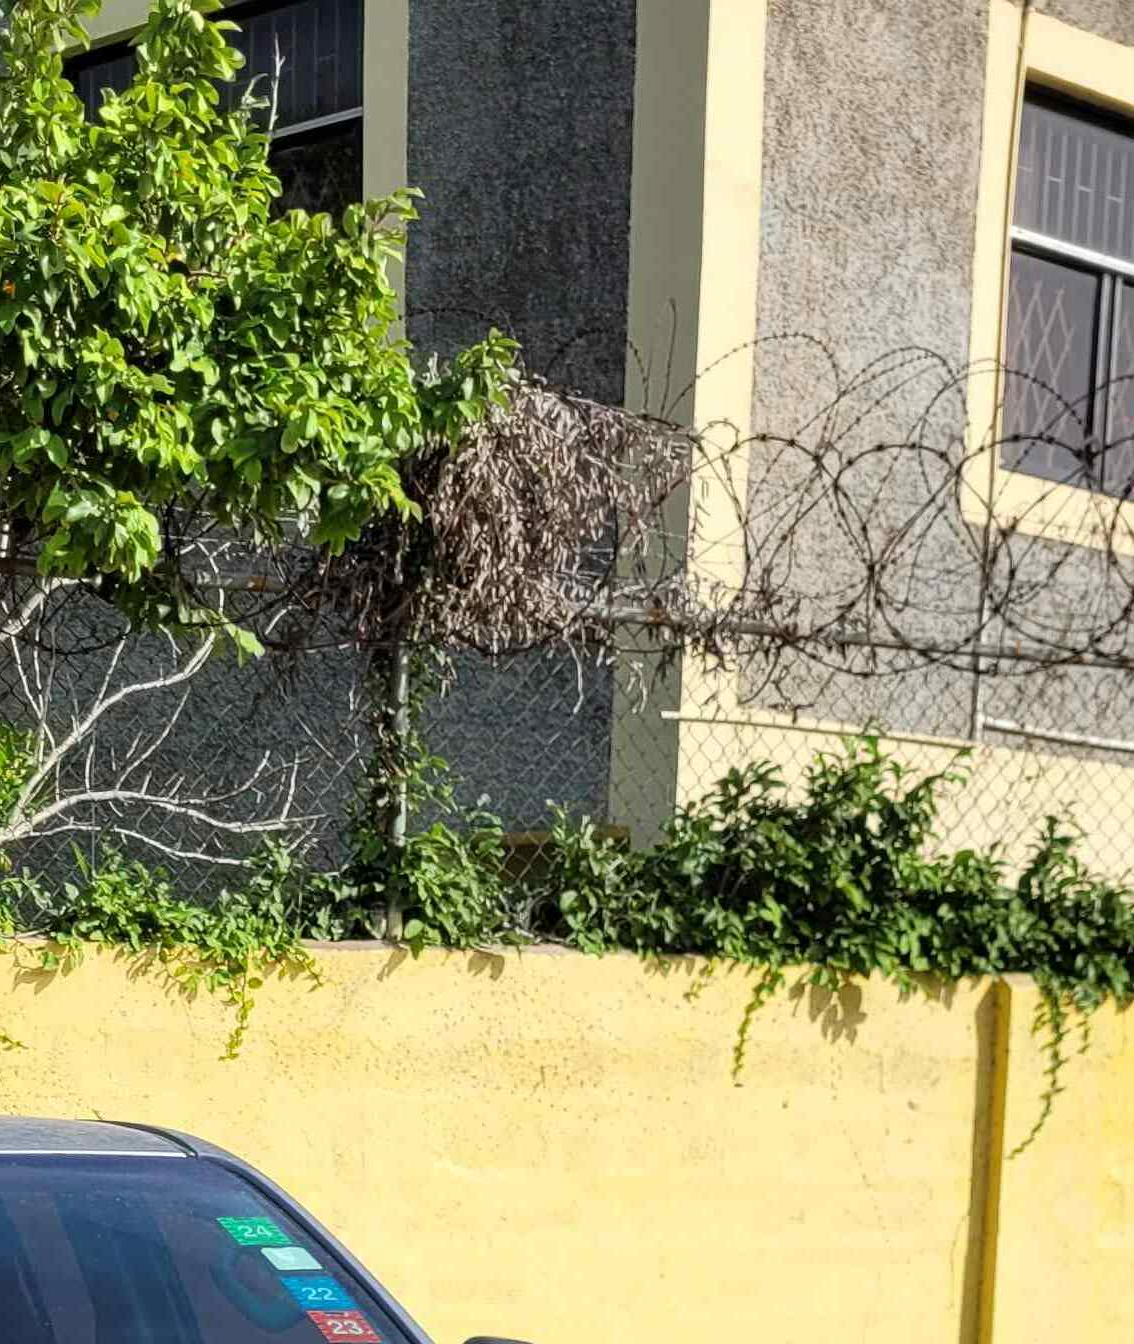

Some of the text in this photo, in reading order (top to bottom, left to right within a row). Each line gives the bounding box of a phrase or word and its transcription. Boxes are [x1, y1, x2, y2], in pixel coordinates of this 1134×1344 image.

[237, 1224, 272, 1238] 24
[301, 1287, 339, 1301] 22
[327, 1318, 364, 1335] 23
